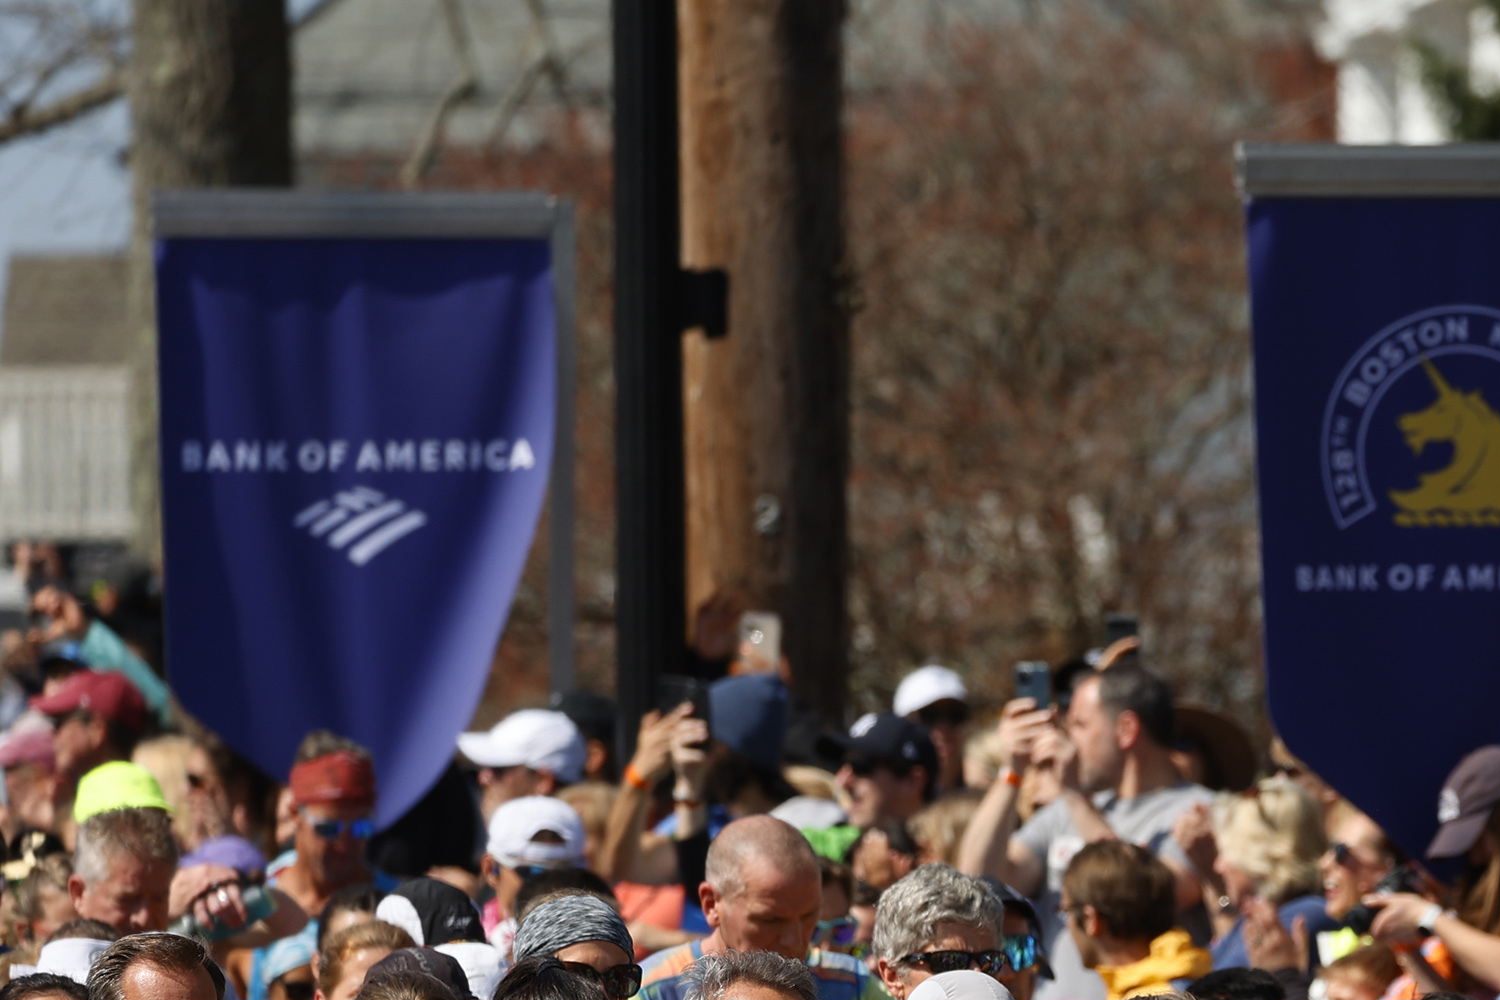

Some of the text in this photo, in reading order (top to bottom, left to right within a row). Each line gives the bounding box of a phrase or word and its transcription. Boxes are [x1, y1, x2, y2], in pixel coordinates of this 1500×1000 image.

[1343, 316, 1471, 408] BOSTON
[181, 438, 536, 473] BANK OF AMERICA
[1295, 564, 1379, 591] BANK
[1386, 564, 1434, 590] OF
